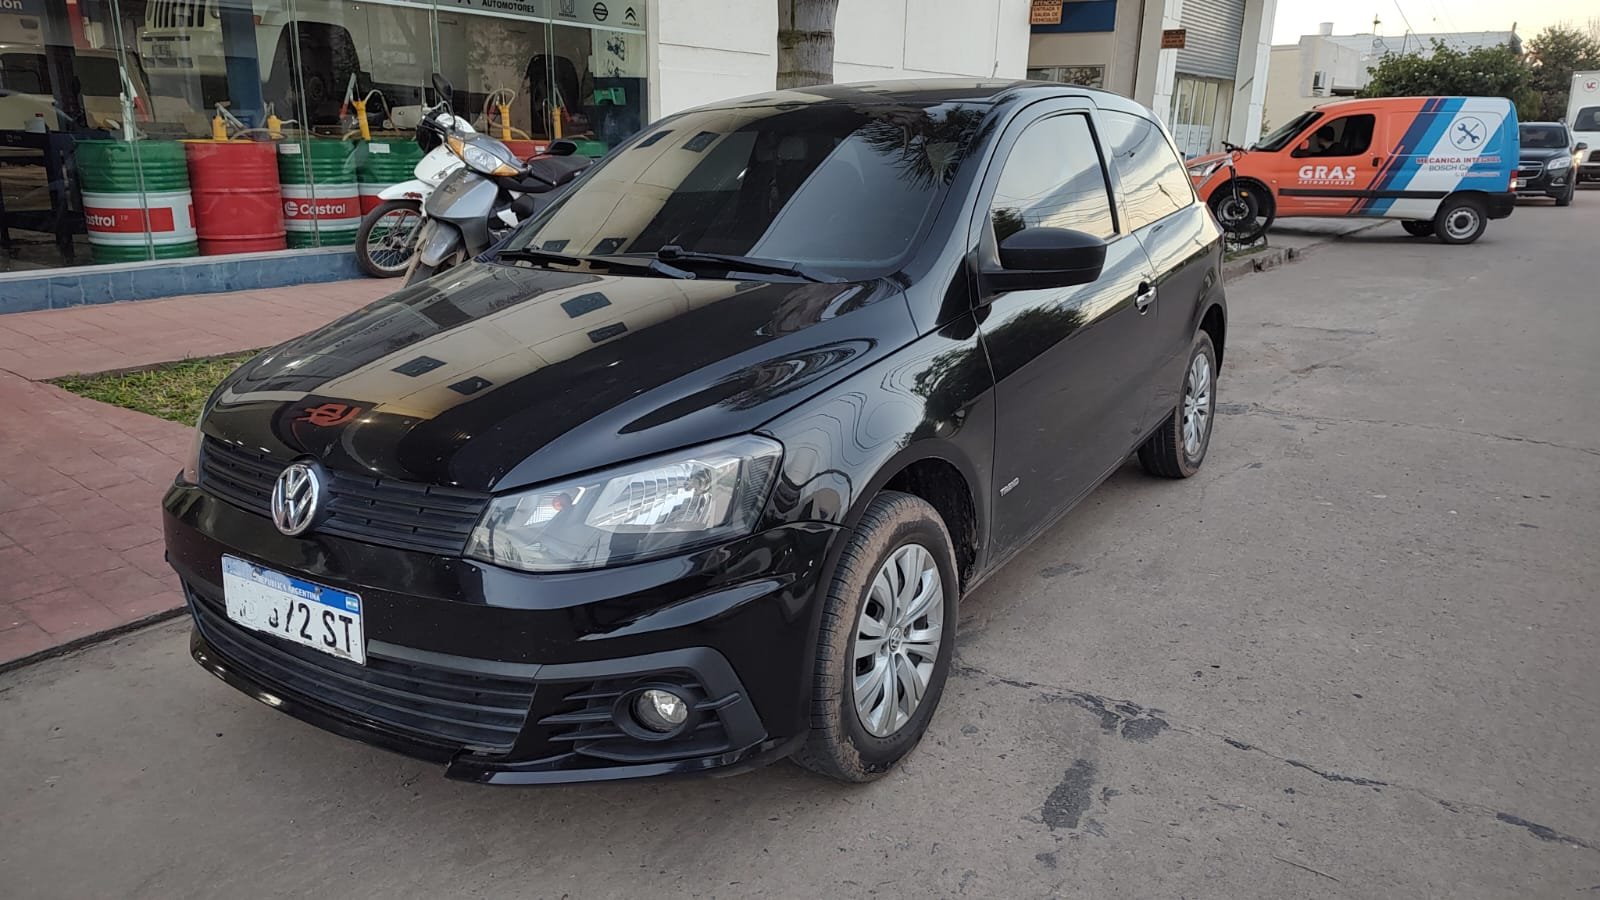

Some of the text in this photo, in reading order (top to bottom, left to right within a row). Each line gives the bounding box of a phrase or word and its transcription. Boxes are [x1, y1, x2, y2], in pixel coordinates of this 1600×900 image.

[482, 0, 535, 13] AUTOMOTORES
[1298, 165, 1357, 180] GRAS
[300, 203, 346, 216] Castrol
[321, 609, 353, 653] ST
